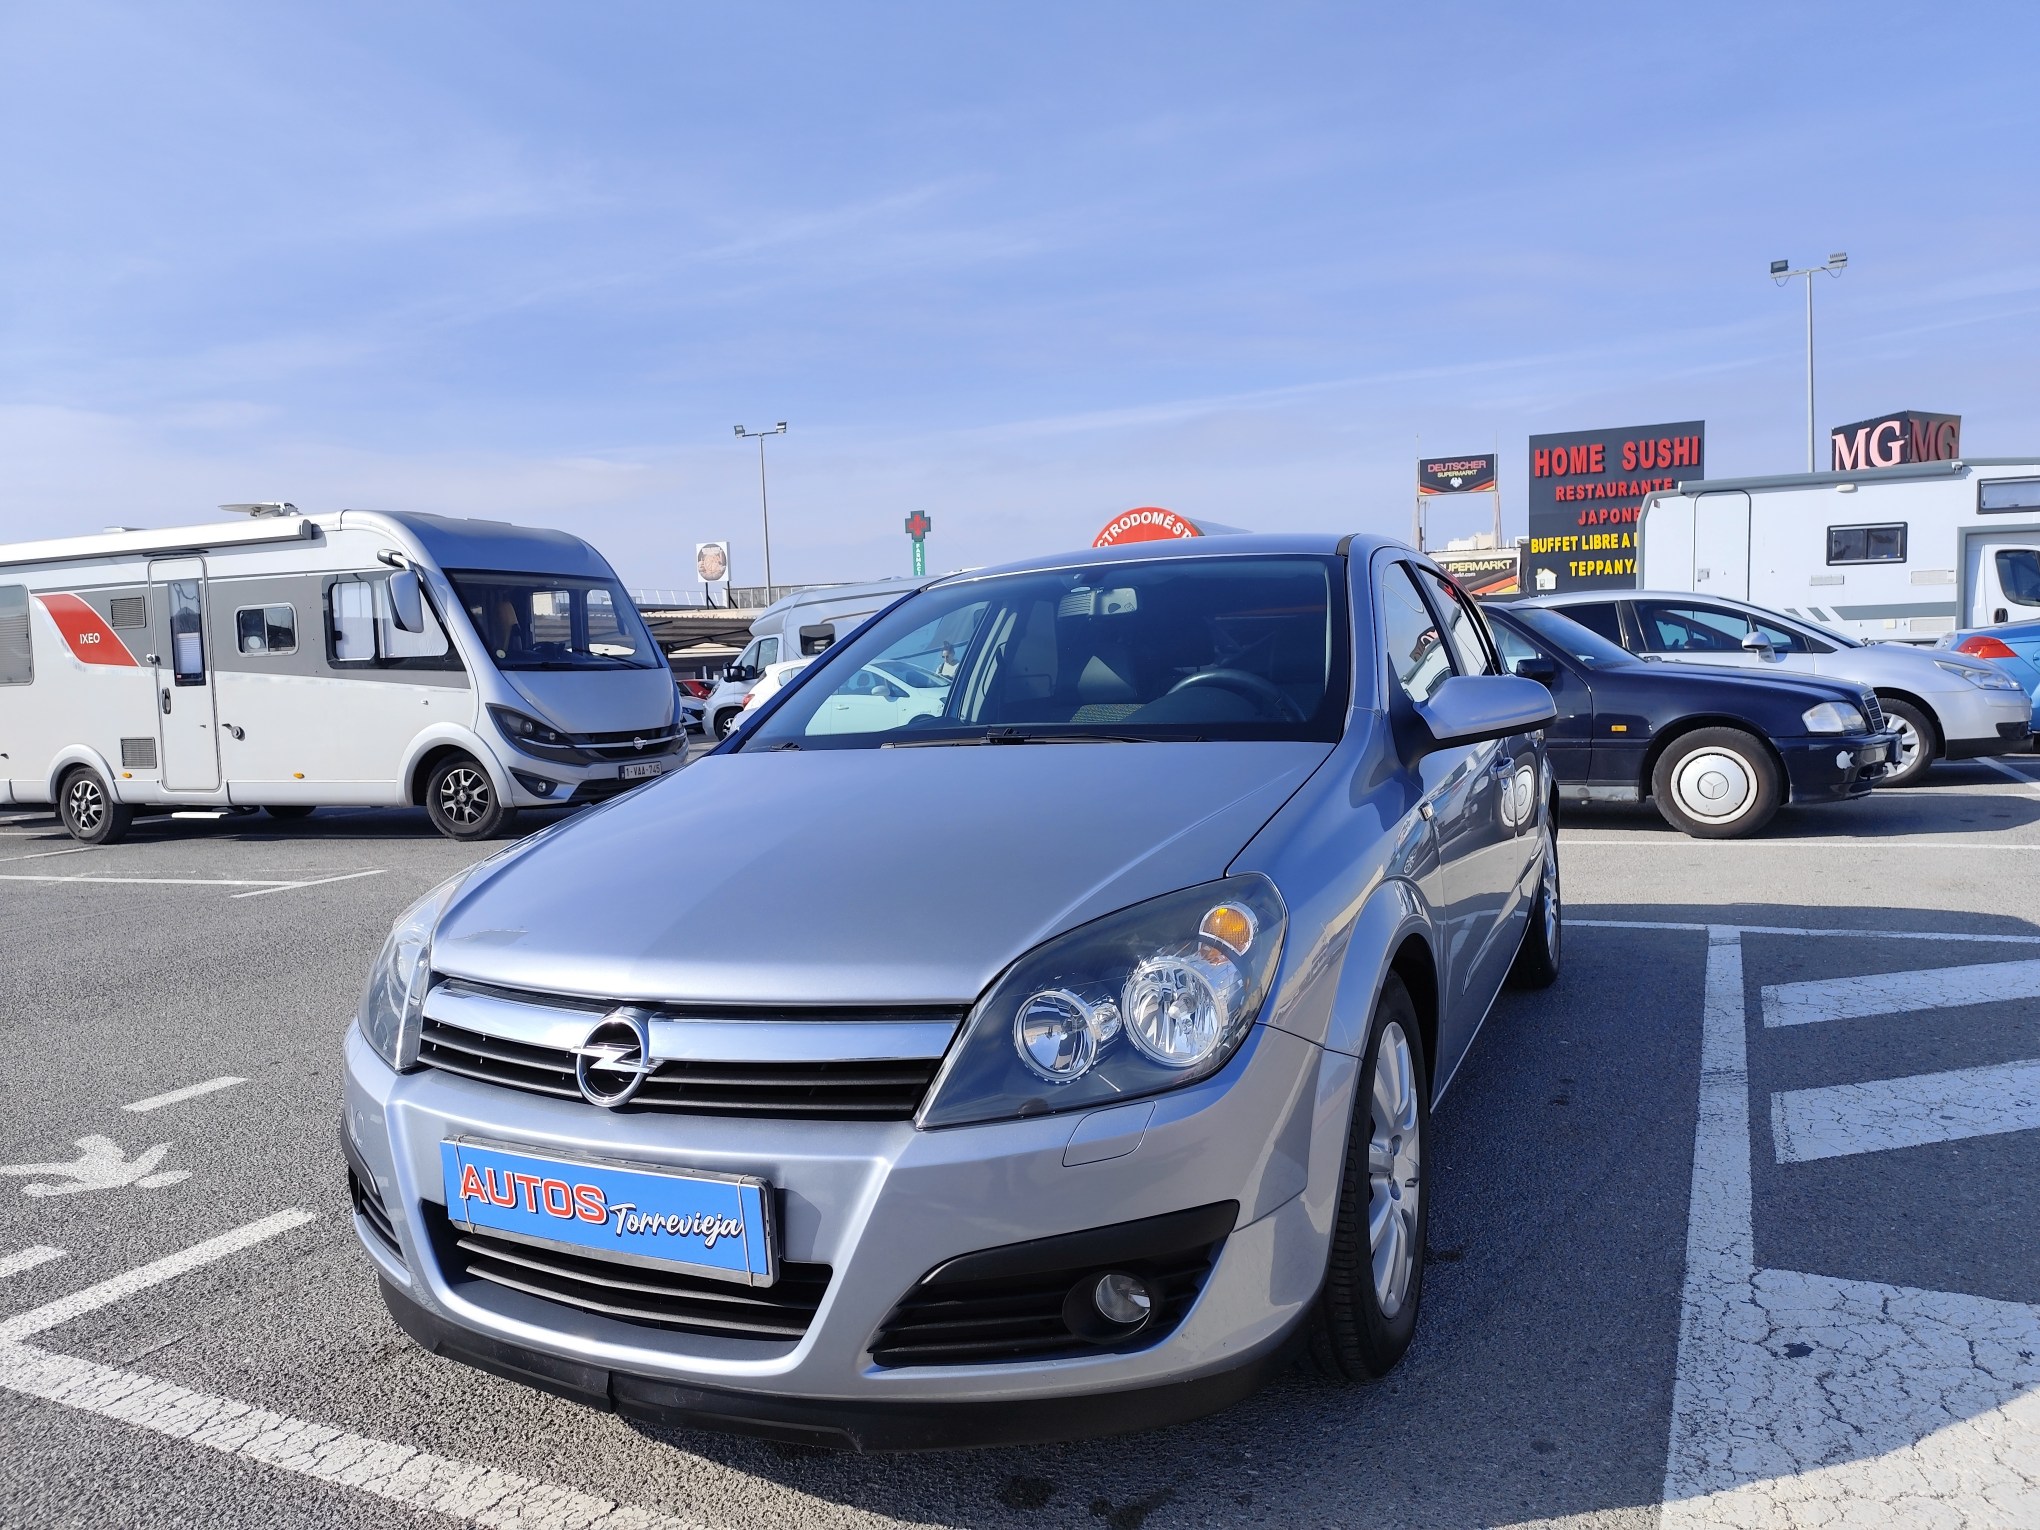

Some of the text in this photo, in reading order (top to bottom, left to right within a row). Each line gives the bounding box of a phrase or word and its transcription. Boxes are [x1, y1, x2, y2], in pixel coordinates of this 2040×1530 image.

[1832, 420, 1905, 471] MG
[1909, 418, 1959, 462] MG
[1428, 460, 1487, 472] DEUTSCHER
[1534, 436, 1699, 477] HOME SUSHI
[1437, 469, 1478, 478] SUPERMARKT
[1555, 477, 1673, 501] RESTAURANTE
[1531, 535, 1578, 553] BUFFET
[1581, 533, 1618, 551] LIBRE
[1621, 532, 1631, 549] A
[79, 632, 100, 645] IXEO
[625, 764, 661, 777] 1-VAA-745
[460, 1163, 744, 1248] AUTOS Torrevieja
